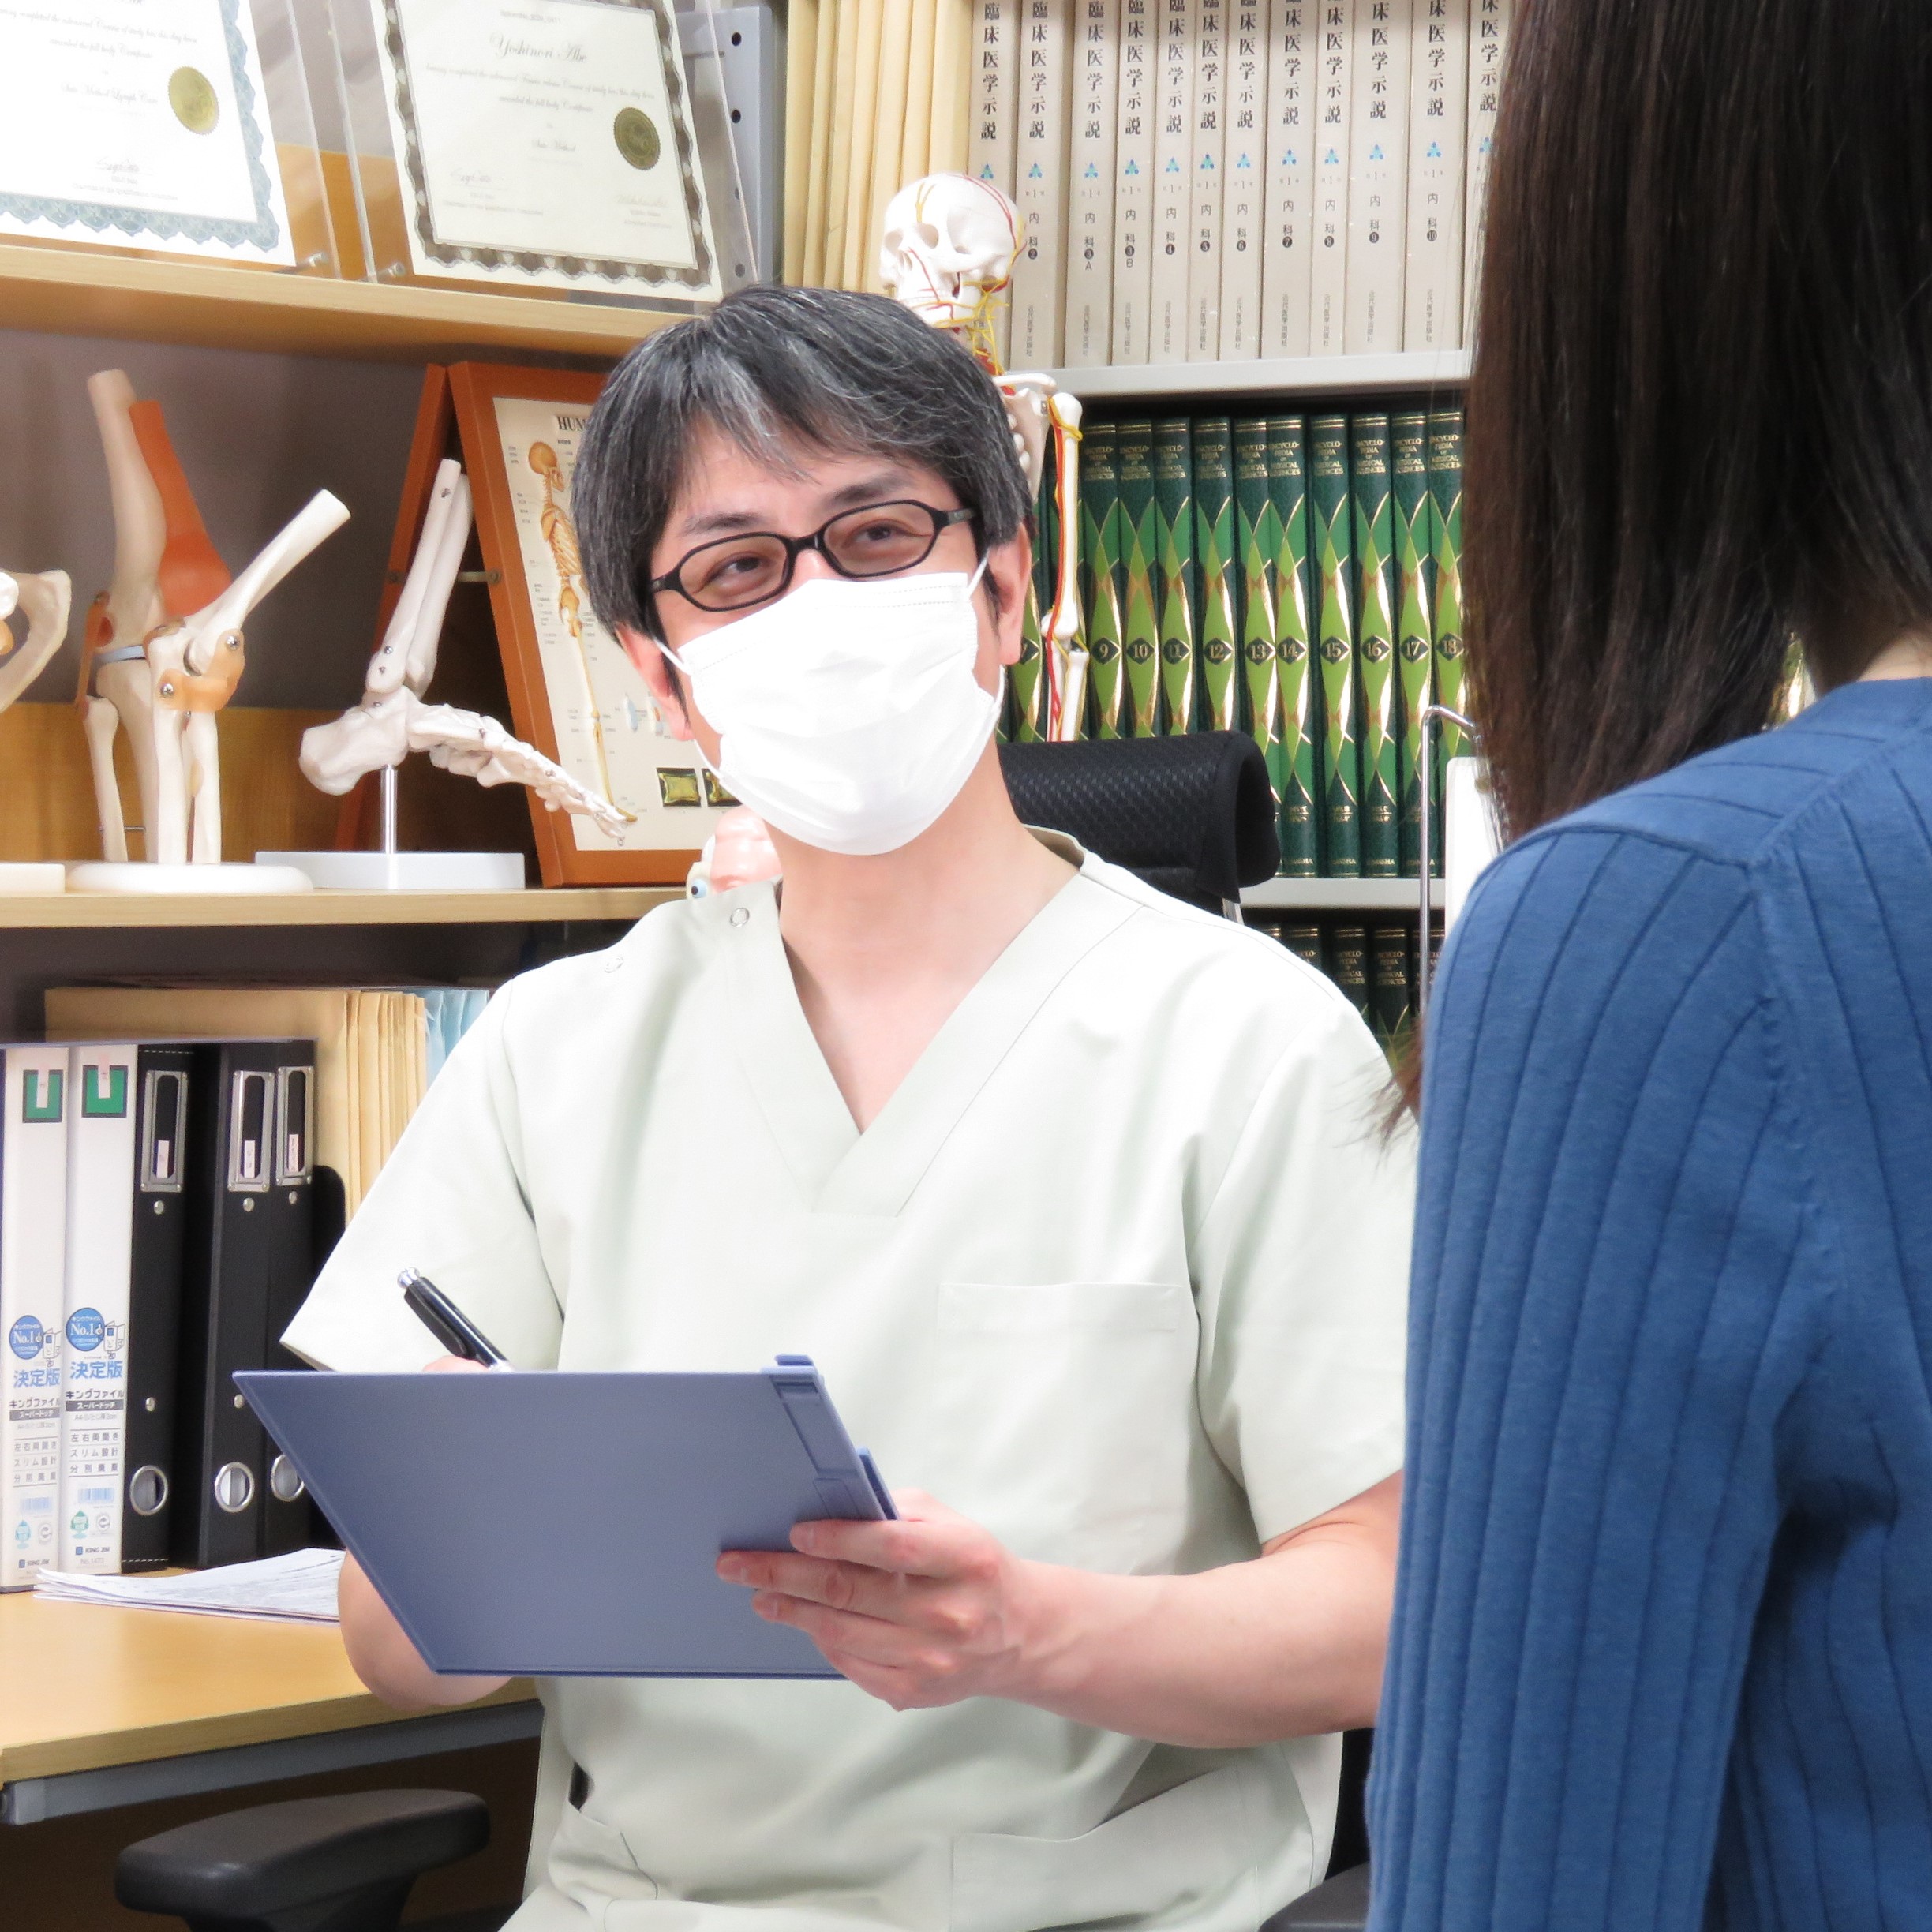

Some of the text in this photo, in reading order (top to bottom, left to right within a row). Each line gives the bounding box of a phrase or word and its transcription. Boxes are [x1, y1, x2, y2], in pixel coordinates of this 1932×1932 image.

[1282, 0, 1301, 125] 床医学示説
[1325, 0, 1343, 123] 床医学示説
[1370, 2, 1387, 118] 床医学示説
[1427, 0, 1444, 116] 床医学示説
[981, 2, 999, 139] 臨床医学示説
[1029, 1, 1048, 138] 臨床医学示説
[1085, 1, 1104, 138] 臨床医学示説
[1099, 643, 1109, 658] 9
[1133, 643, 1148, 658] 10
[1210, 643, 1224, 659] 12
[1252, 642, 1267, 659] 13
[1282, 642, 1299, 658] 14
[1326, 641, 1342, 657] 15
[1367, 640, 1382, 656] 16
[1406, 640, 1421, 656] 17
[1443, 638, 1458, 654] 18
[70, 1322, 95, 1335] No.1
[13, 1330, 34, 1344] No.1
[13, 1368, 61, 1387] 決定版
[70, 1361, 124, 1380] 決定版
[66, 1388, 125, 1399] キングファイル
